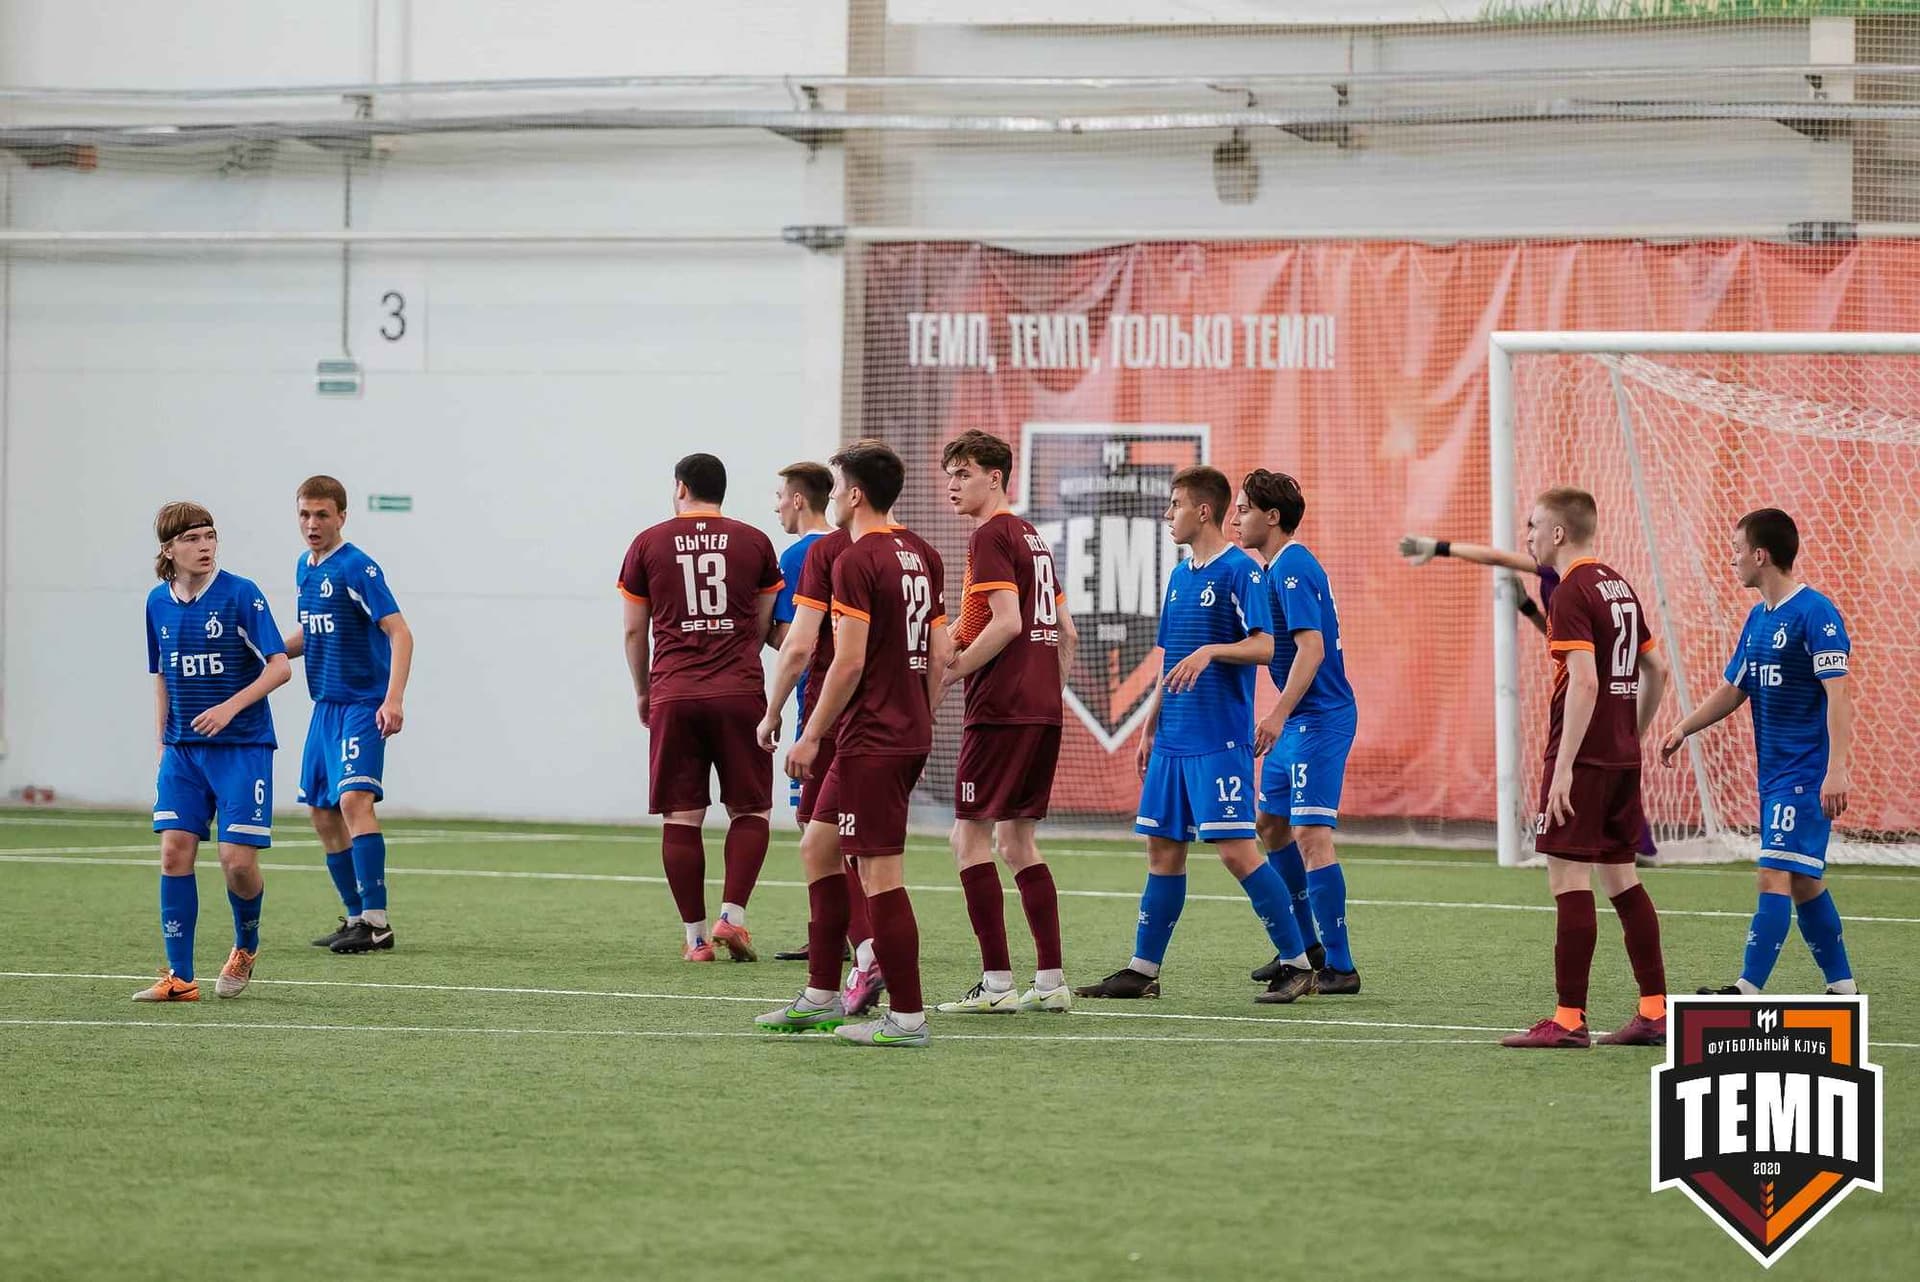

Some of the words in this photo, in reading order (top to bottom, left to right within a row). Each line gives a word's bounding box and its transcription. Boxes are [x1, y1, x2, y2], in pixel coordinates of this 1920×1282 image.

[380, 291, 405, 341] 3
[908, 312, 996, 374] ТЕМП,
[1008, 313, 1100, 374] ТЕМП,
[1108, 313, 1233, 369] ТОЛЬКО
[1243, 313, 1335, 369] ТЕМП!
[674, 534, 728, 552] СЫЧЕВ
[676, 553, 727, 616] 13
[1033, 555, 1057, 625] 18
[309, 613, 335, 634] ВТБ
[681, 618, 734, 632] SEUS
[901, 574, 931, 651] 22
[1610, 602, 1638, 677] 27
[181, 652, 225, 677] ВТБ
[341, 737, 360, 761] 15
[1292, 763, 1308, 788] 13
[254, 779, 265, 805] 6
[961, 782, 975, 803] 18
[1216, 776, 1242, 802] 12
[838, 813, 855, 836] 22
[1770, 803, 1796, 832] 18
